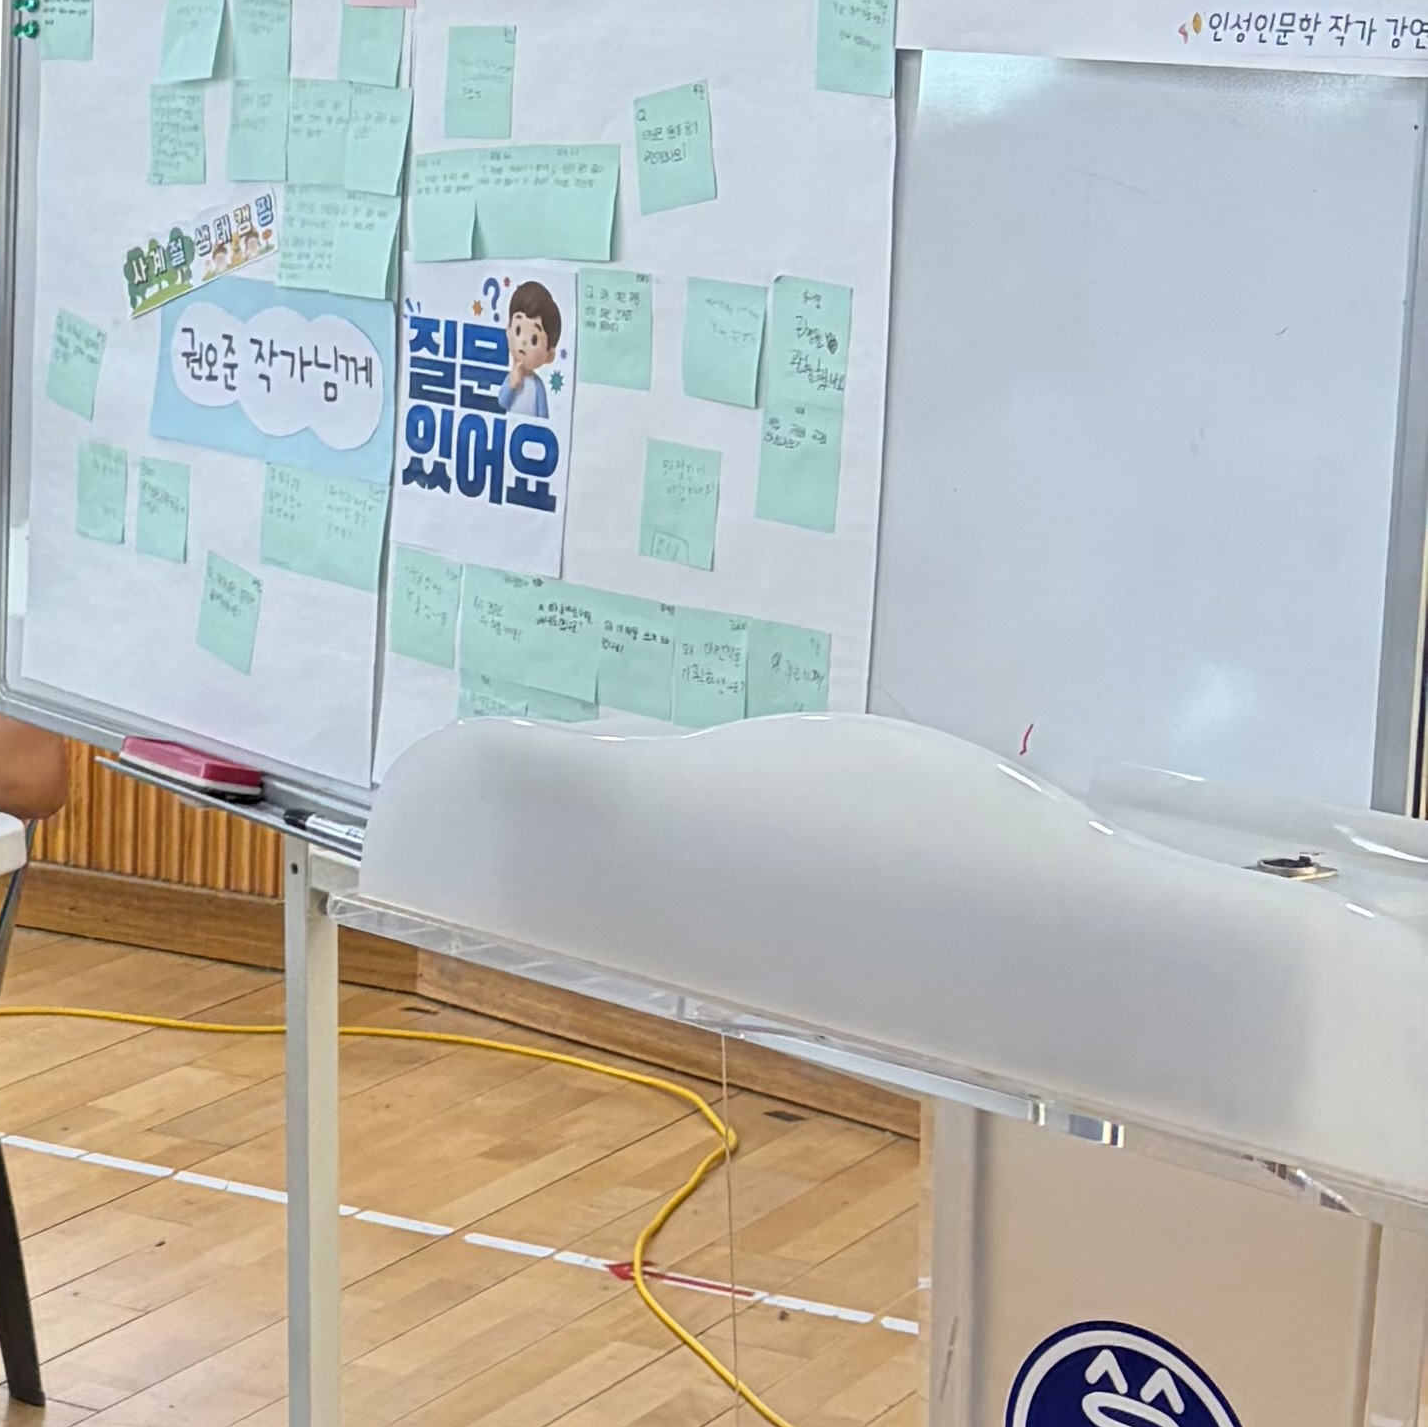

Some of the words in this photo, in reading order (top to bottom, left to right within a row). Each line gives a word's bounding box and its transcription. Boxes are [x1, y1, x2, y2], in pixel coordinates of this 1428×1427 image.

[1208, 11, 1322, 46] 인성인문학
[1328, 13, 1377, 47] 작가
[181, 326, 240, 391] 권오준
[249, 337, 374, 403] 작가님께
[408, 314, 511, 415] 질문
[401, 404, 560, 514] 있어요
